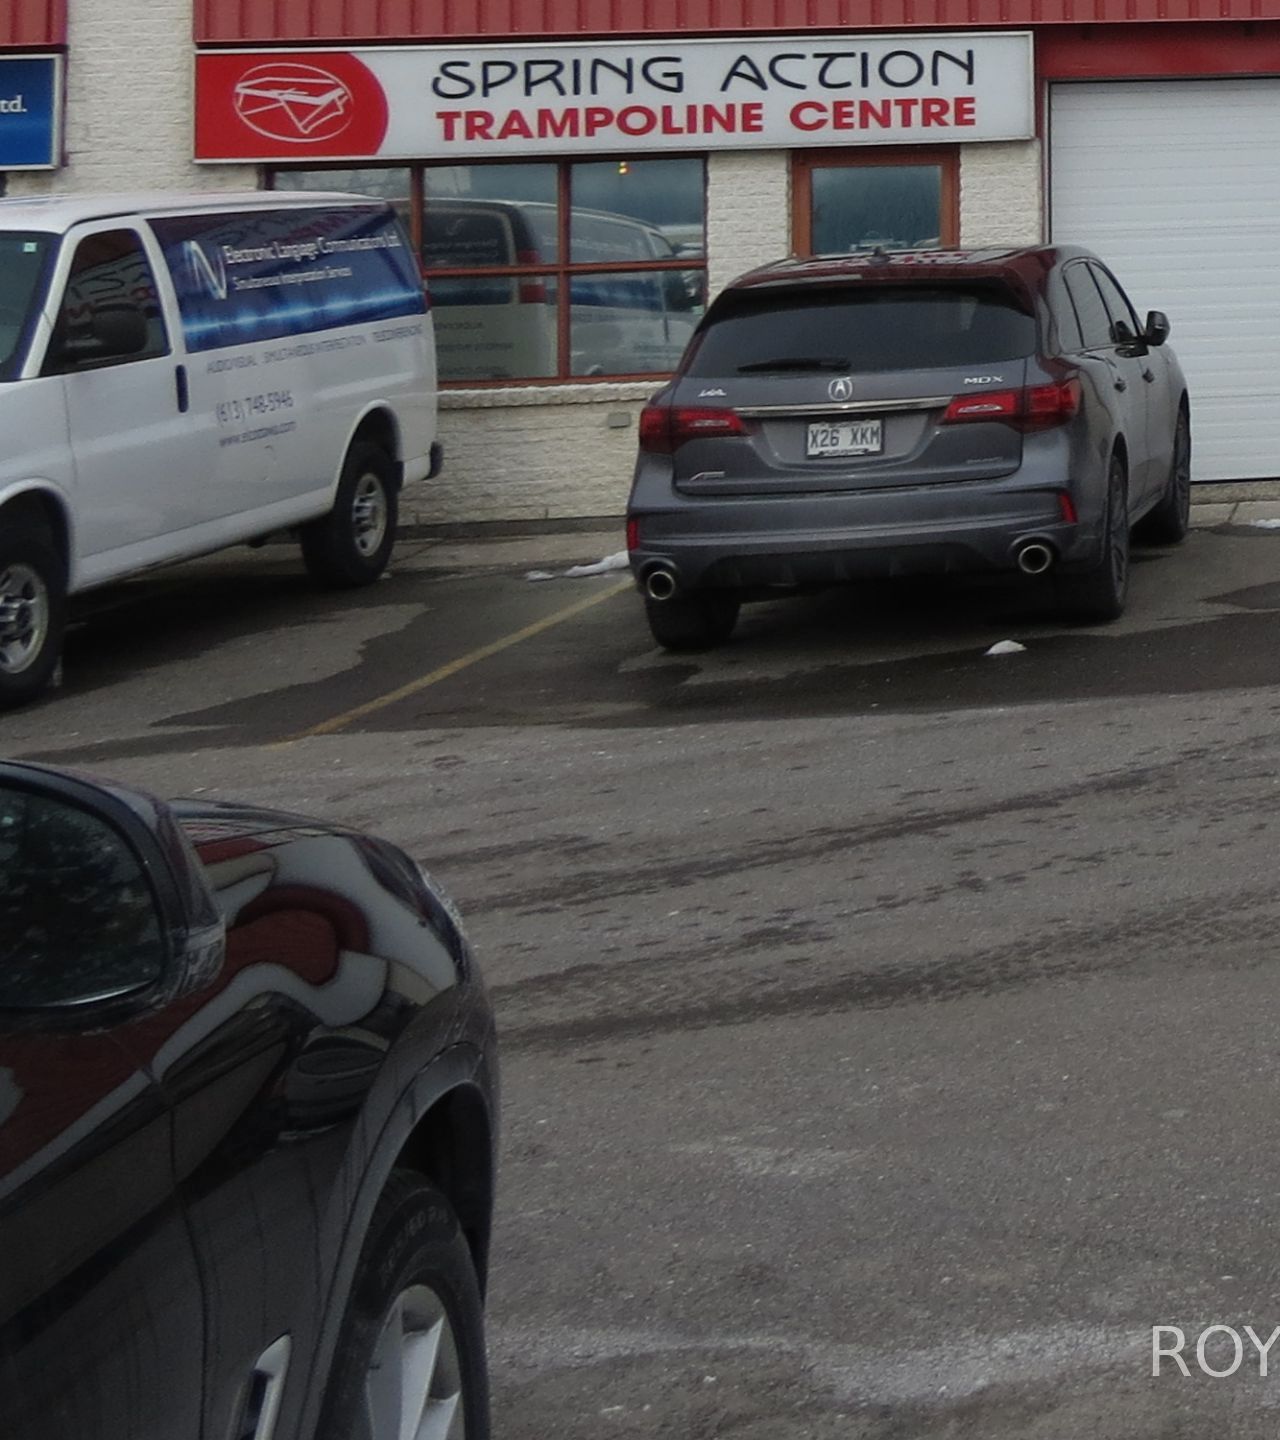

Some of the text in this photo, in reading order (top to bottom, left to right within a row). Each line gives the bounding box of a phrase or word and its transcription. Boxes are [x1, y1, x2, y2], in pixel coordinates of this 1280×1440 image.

[432, 49, 974, 99] SPRING ACTION
[436, 96, 976, 141] TRAMPOLINE CENTRE
[964, 376, 1004, 385] MDX
[809, 428, 840, 448] X26
